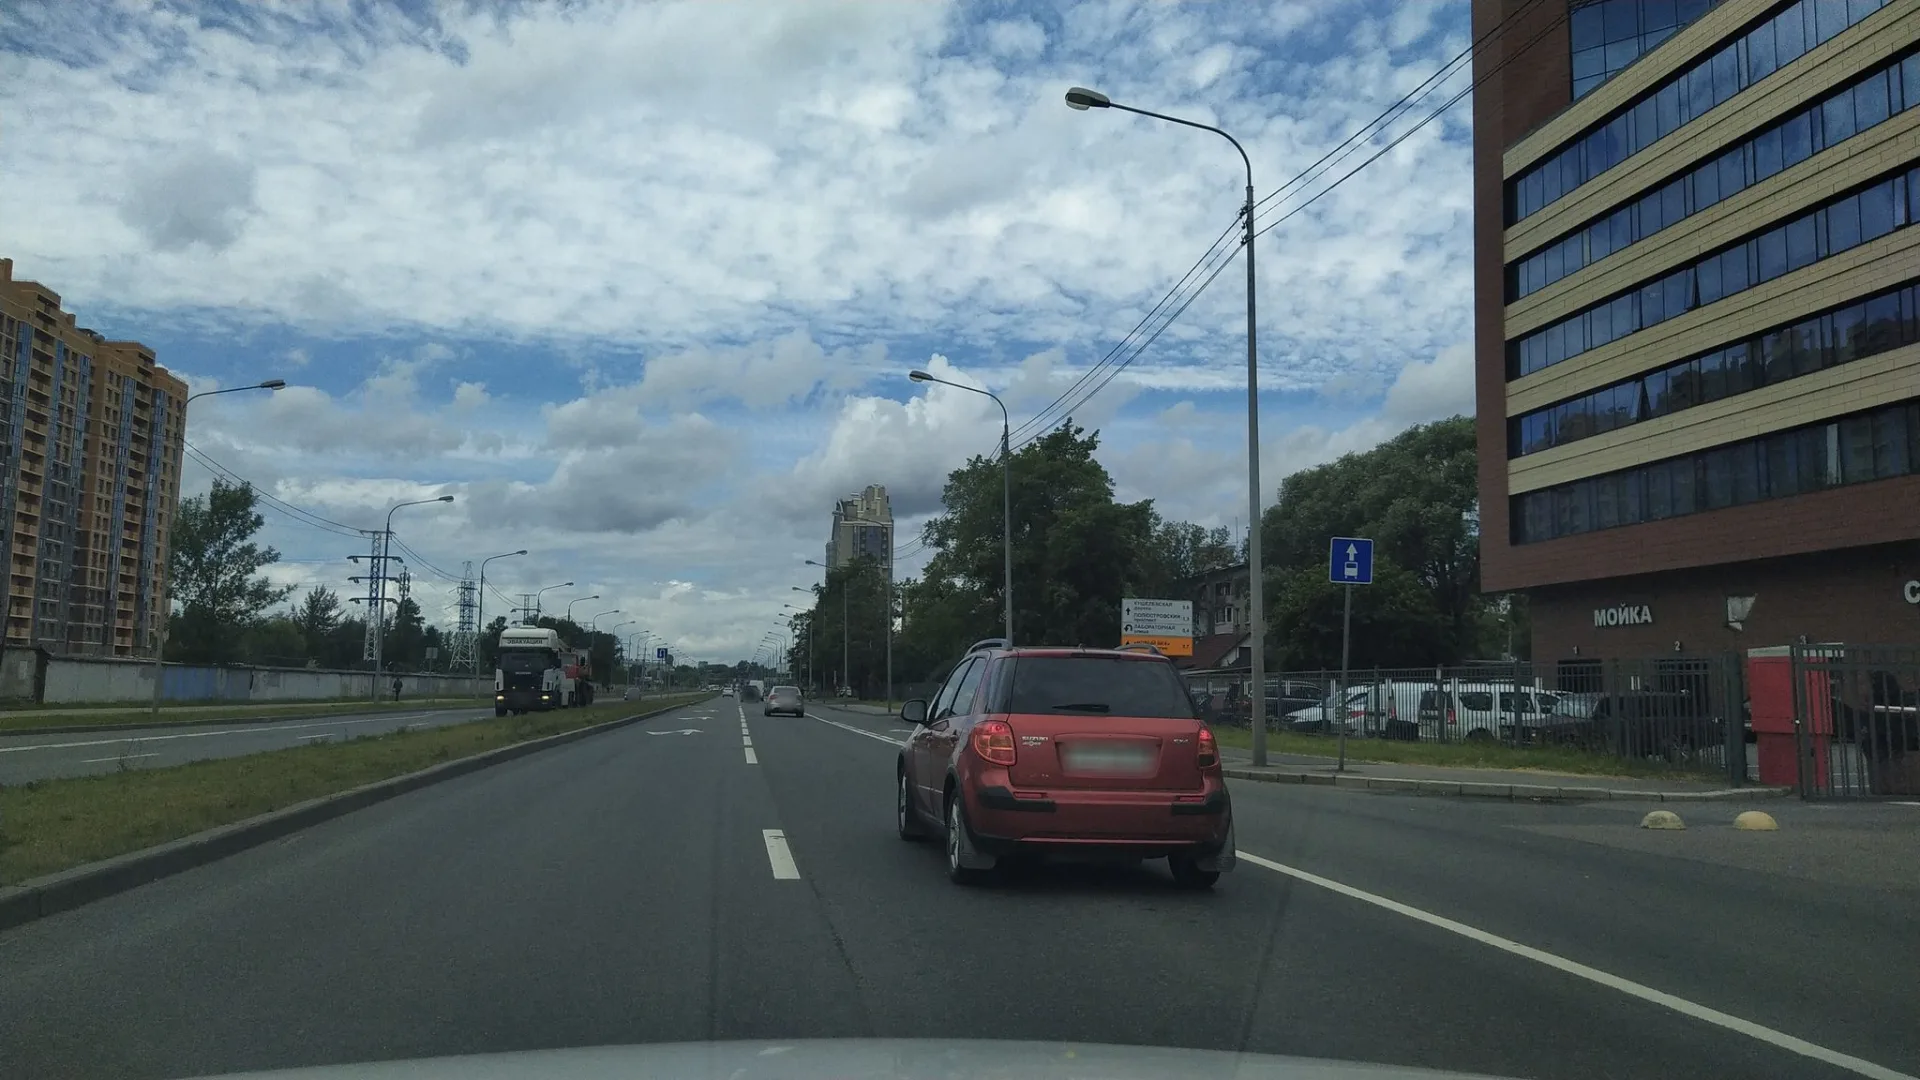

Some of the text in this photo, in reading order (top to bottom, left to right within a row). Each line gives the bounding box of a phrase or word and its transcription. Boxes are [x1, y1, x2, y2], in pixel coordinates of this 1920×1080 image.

[1594, 602, 1653, 627] МОЙКА
[1572, 645, 1578, 655] 1
[1674, 640, 1681, 651] 2
